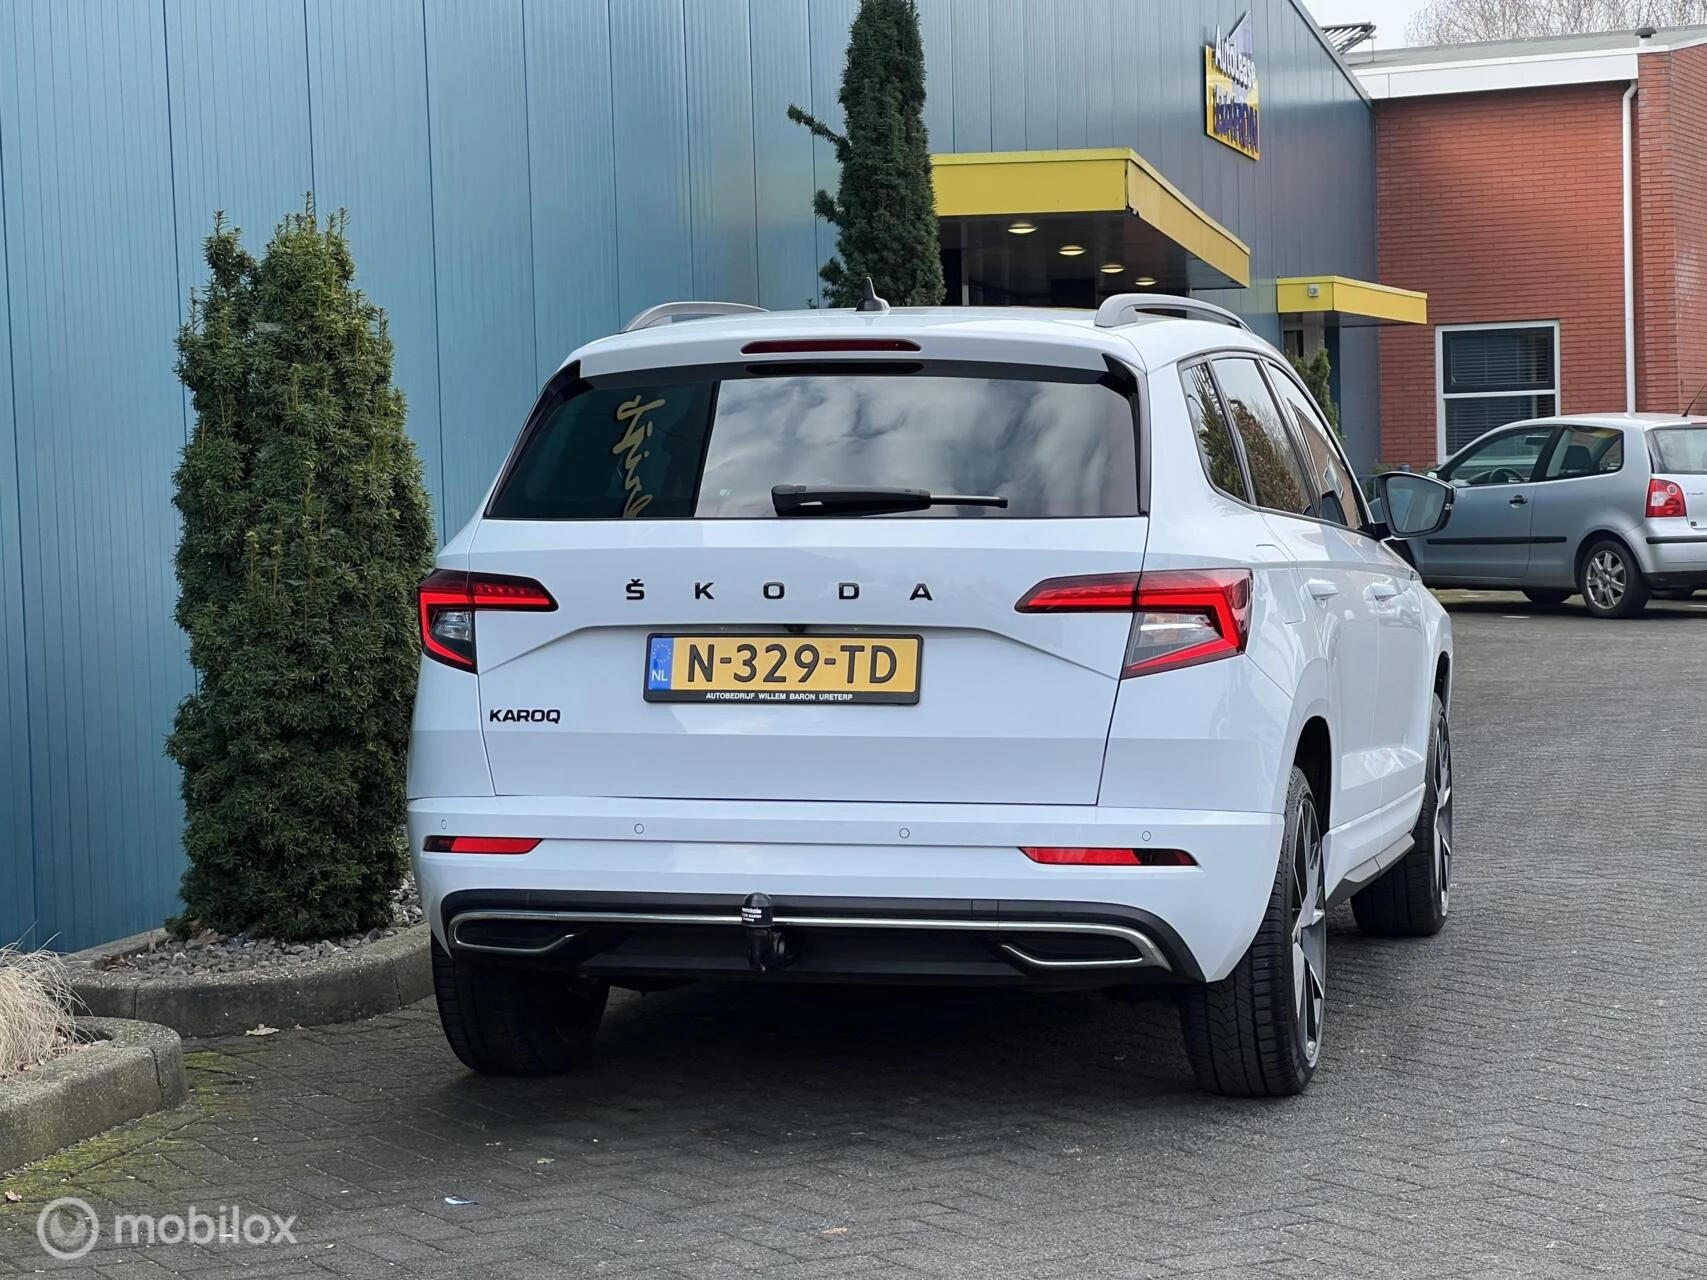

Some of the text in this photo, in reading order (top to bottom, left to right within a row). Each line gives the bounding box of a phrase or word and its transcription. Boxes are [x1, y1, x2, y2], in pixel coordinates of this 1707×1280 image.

[625, 578, 933, 601] ŠKODA
[687, 643, 897, 684] N-329-TD
[651, 669, 668, 682] NL
[705, 692, 755, 700] AUTOBEDRIJF
[758, 692, 786, 700] WILLEM
[819, 693, 853, 701] URETERP
[489, 709, 561, 724] KAROQ
